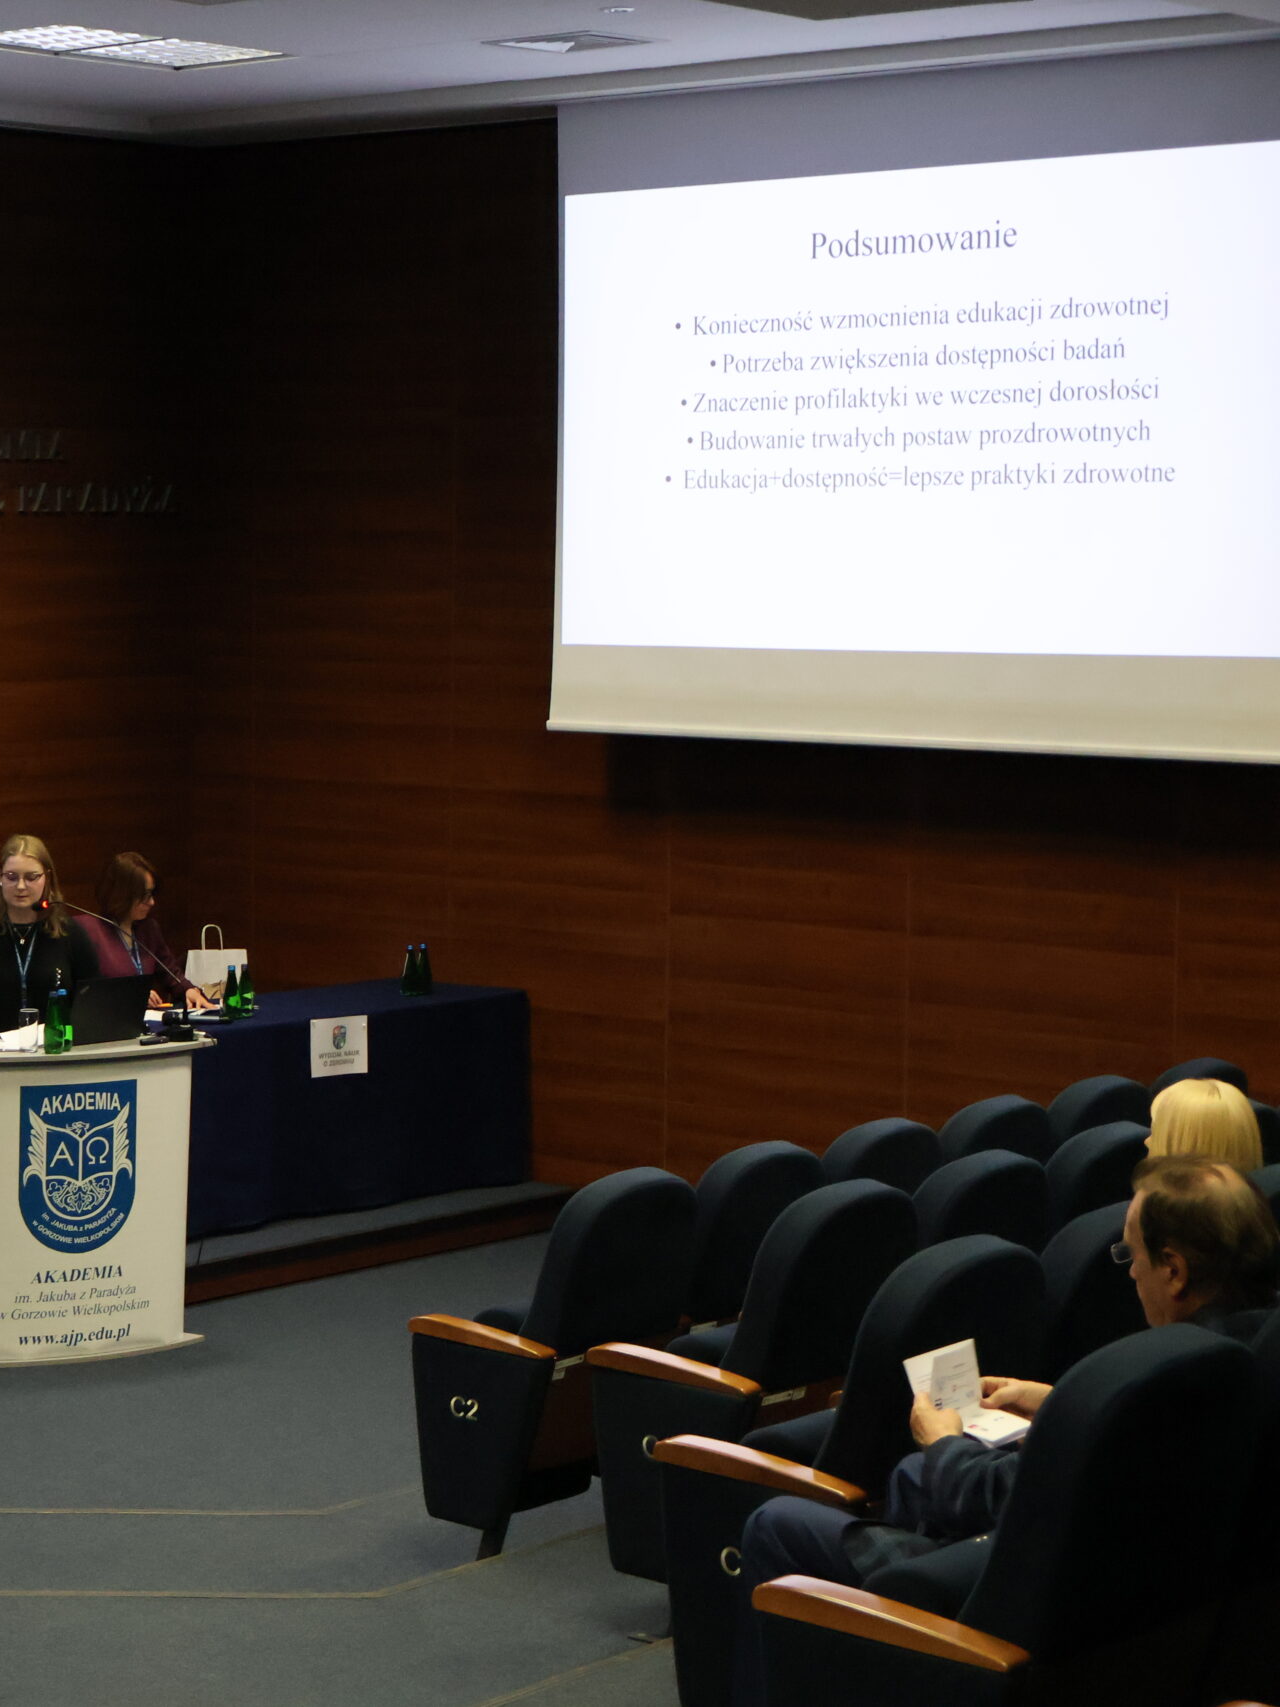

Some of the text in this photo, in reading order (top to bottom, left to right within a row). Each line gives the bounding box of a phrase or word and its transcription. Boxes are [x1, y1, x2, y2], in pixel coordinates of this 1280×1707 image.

[810, 219, 1018, 260] Podsumowanie
[693, 291, 1168, 336] Konieczność wzmocnienia edukacji zdrowotnej
[723, 336, 1127, 375] Potrzeba zwiększenia dostępności badań
[693, 376, 1159, 416] Znaczenie profilaktyki we wczesnej dorosłości
[700, 419, 1151, 453] Budowanie trwałych postaw prozdrowotnych
[684, 462, 1176, 494] Edukacja+dostępność=lepsze praktyki zdrowotne
[40, 1091, 121, 1117] AKADEMIA
[37, 1224, 74, 1244] GORZOWIE
[51, 1219, 78, 1232] JAKUBA
[31, 1265, 123, 1284] AKADEMIA
[14, 1283, 138, 1304] im. Jakuba z Paradyża
[11, 1307, 69, 1321] Gorzowie
[72, 1298, 150, 1317] Wielkopolskim
[18, 1323, 132, 1347] www.ajp.edu.pl
[450, 1395, 479, 1422] C2
